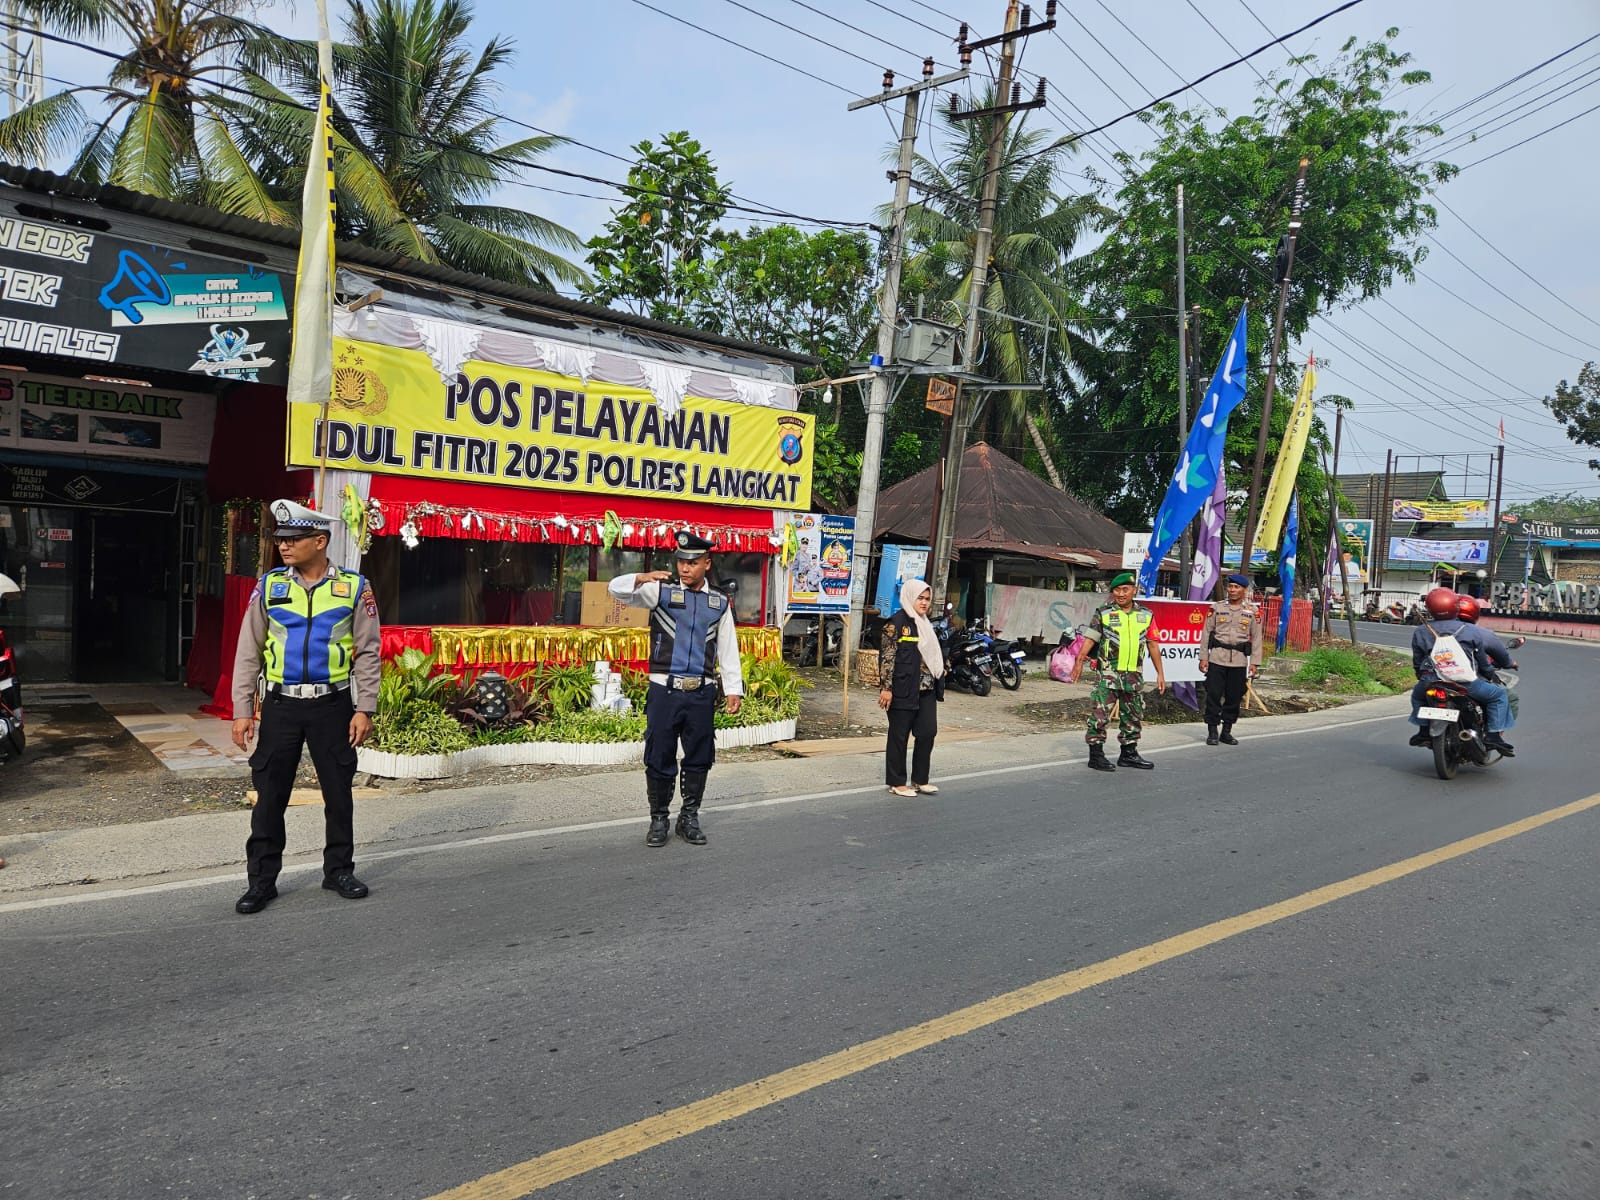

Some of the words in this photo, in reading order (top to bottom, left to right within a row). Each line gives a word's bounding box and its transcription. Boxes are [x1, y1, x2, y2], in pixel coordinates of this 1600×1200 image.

[18, 223, 94, 263] BOX
[7, 269, 62, 307] BK
[37, 325, 121, 363] ALIS
[19, 381, 182, 419] TERBAIK
[444, 371, 523, 430] POS
[529, 383, 731, 457] PELAYANAN
[410, 430, 498, 476] FITRI
[504, 442, 580, 484] 2025
[586, 452, 687, 496] POLRES
[691, 464, 801, 504] LANGKAT
[1522, 523, 1562, 537] SAFARI
[1158, 629, 1190, 642] OLRI
